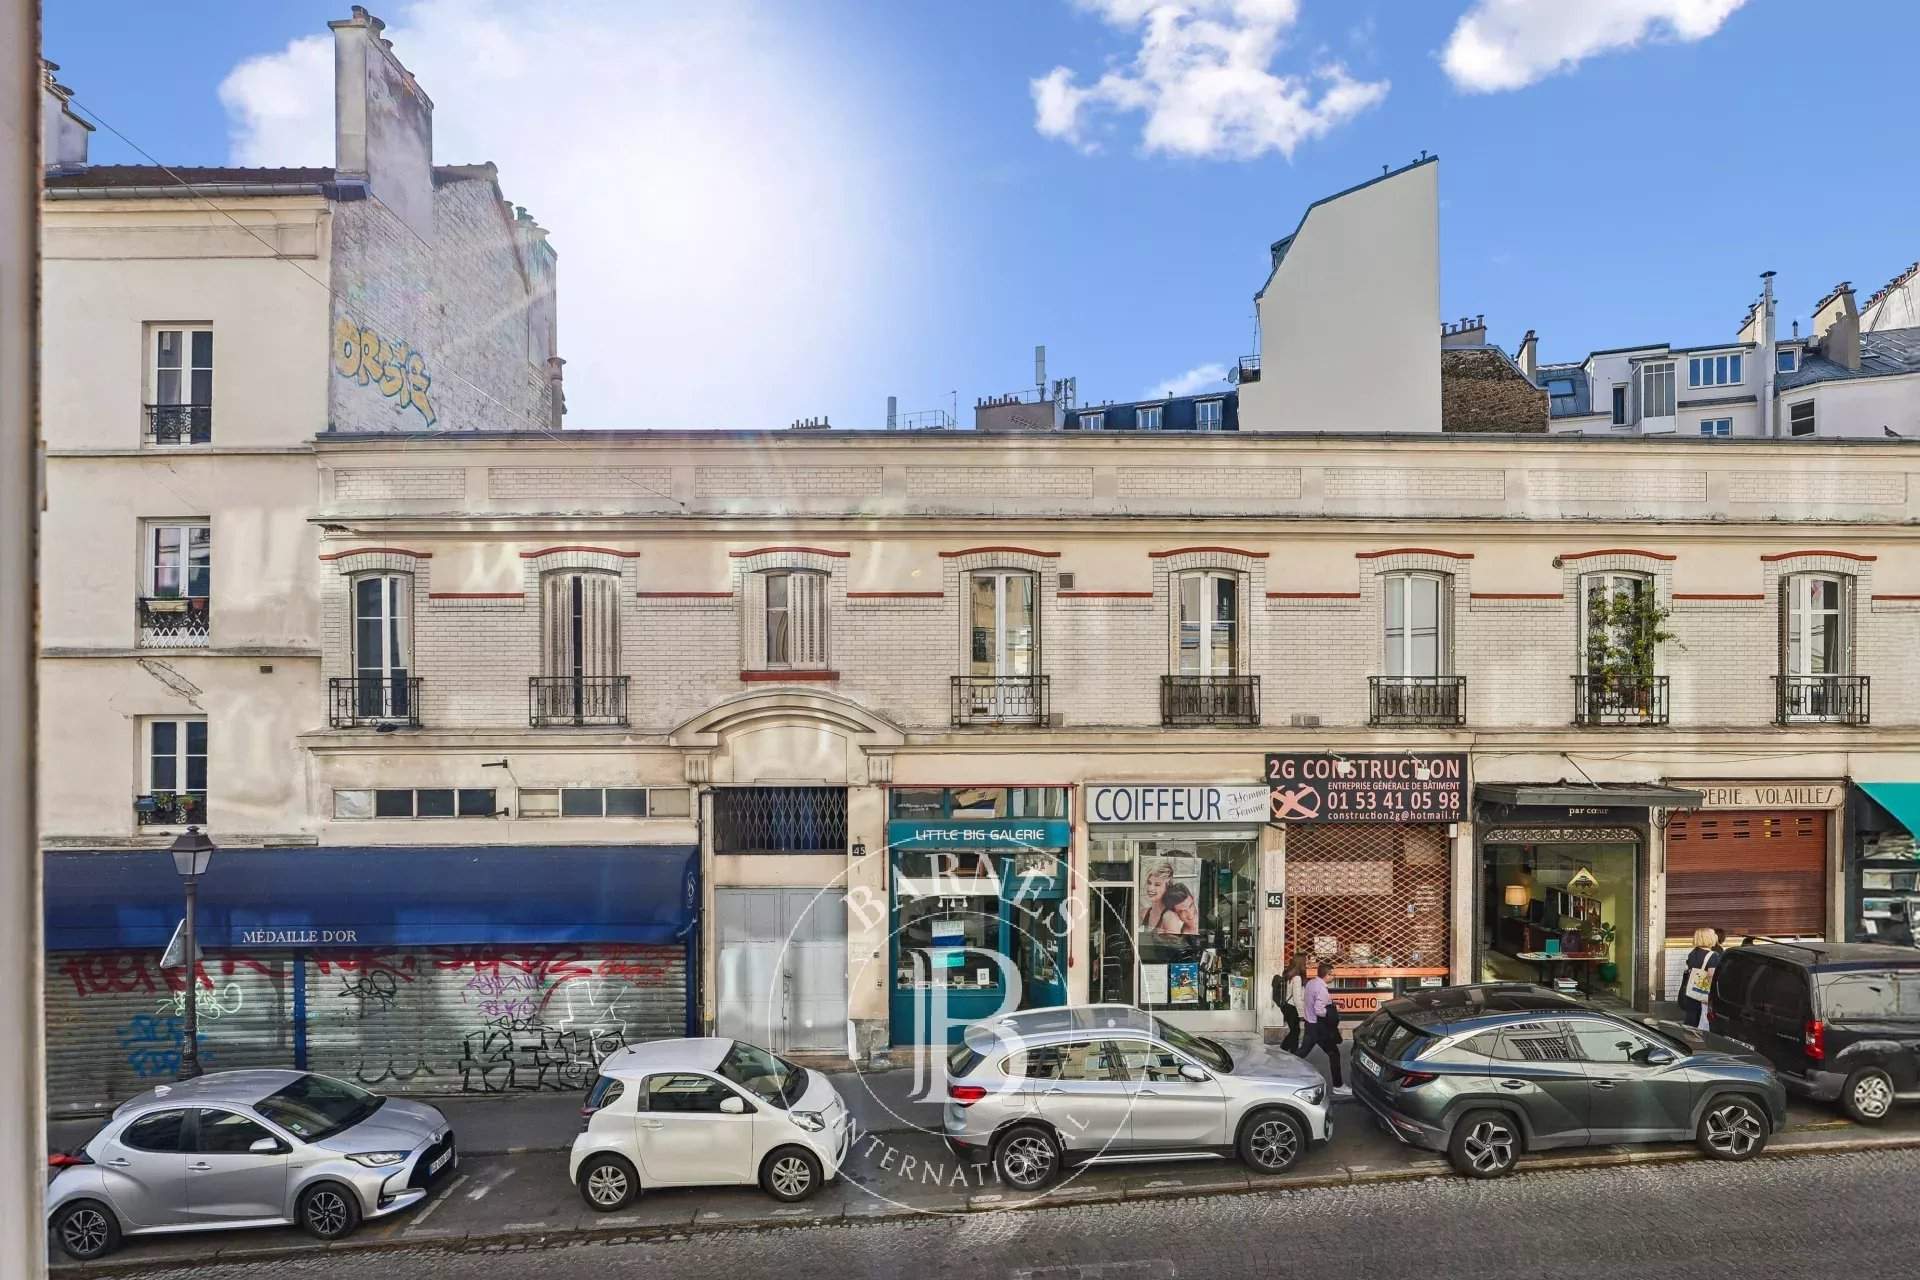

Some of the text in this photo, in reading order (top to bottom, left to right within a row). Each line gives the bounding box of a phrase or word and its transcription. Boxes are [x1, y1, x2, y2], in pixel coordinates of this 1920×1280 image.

[1270, 760, 1295, 779] 2G
[1328, 780, 1461, 790] ENTREPRISE GÉNÉRALE DE BÂTIMENT
[1226, 788, 1268, 803] Homme
[1327, 791, 1460, 810] 01 53 41 05 98
[1755, 788, 1834, 804] VOLAILLES
[1095, 788, 1221, 821] COIFFEUR
[1228, 803, 1265, 818] Femme
[1327, 811, 1461, 821] construction2g@hotmail.fr
[1569, 808, 1584, 816] par
[915, 829, 1045, 841] LITTLE BIG GALERIE
[853, 845, 866, 856] 45
[1269, 895, 1281, 905] 45
[243, 929, 358, 943] MÉDAILLE D'OR
